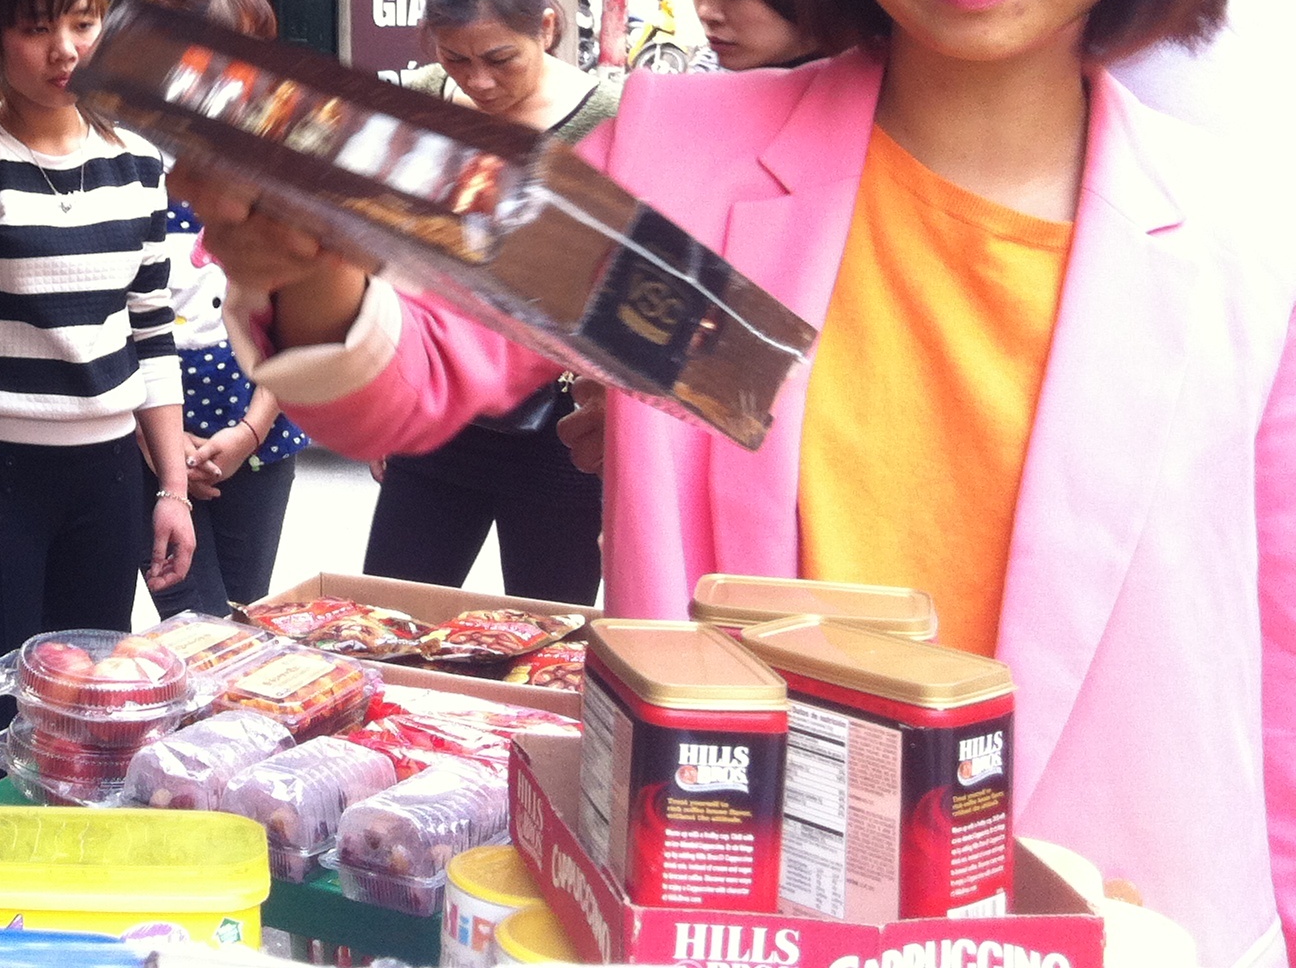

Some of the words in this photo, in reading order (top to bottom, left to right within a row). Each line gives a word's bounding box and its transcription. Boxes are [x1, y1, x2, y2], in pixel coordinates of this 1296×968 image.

[678, 743, 750, 767] HILLS
[959, 731, 1003, 762] HILLS
[672, 923, 800, 965] HILLS
